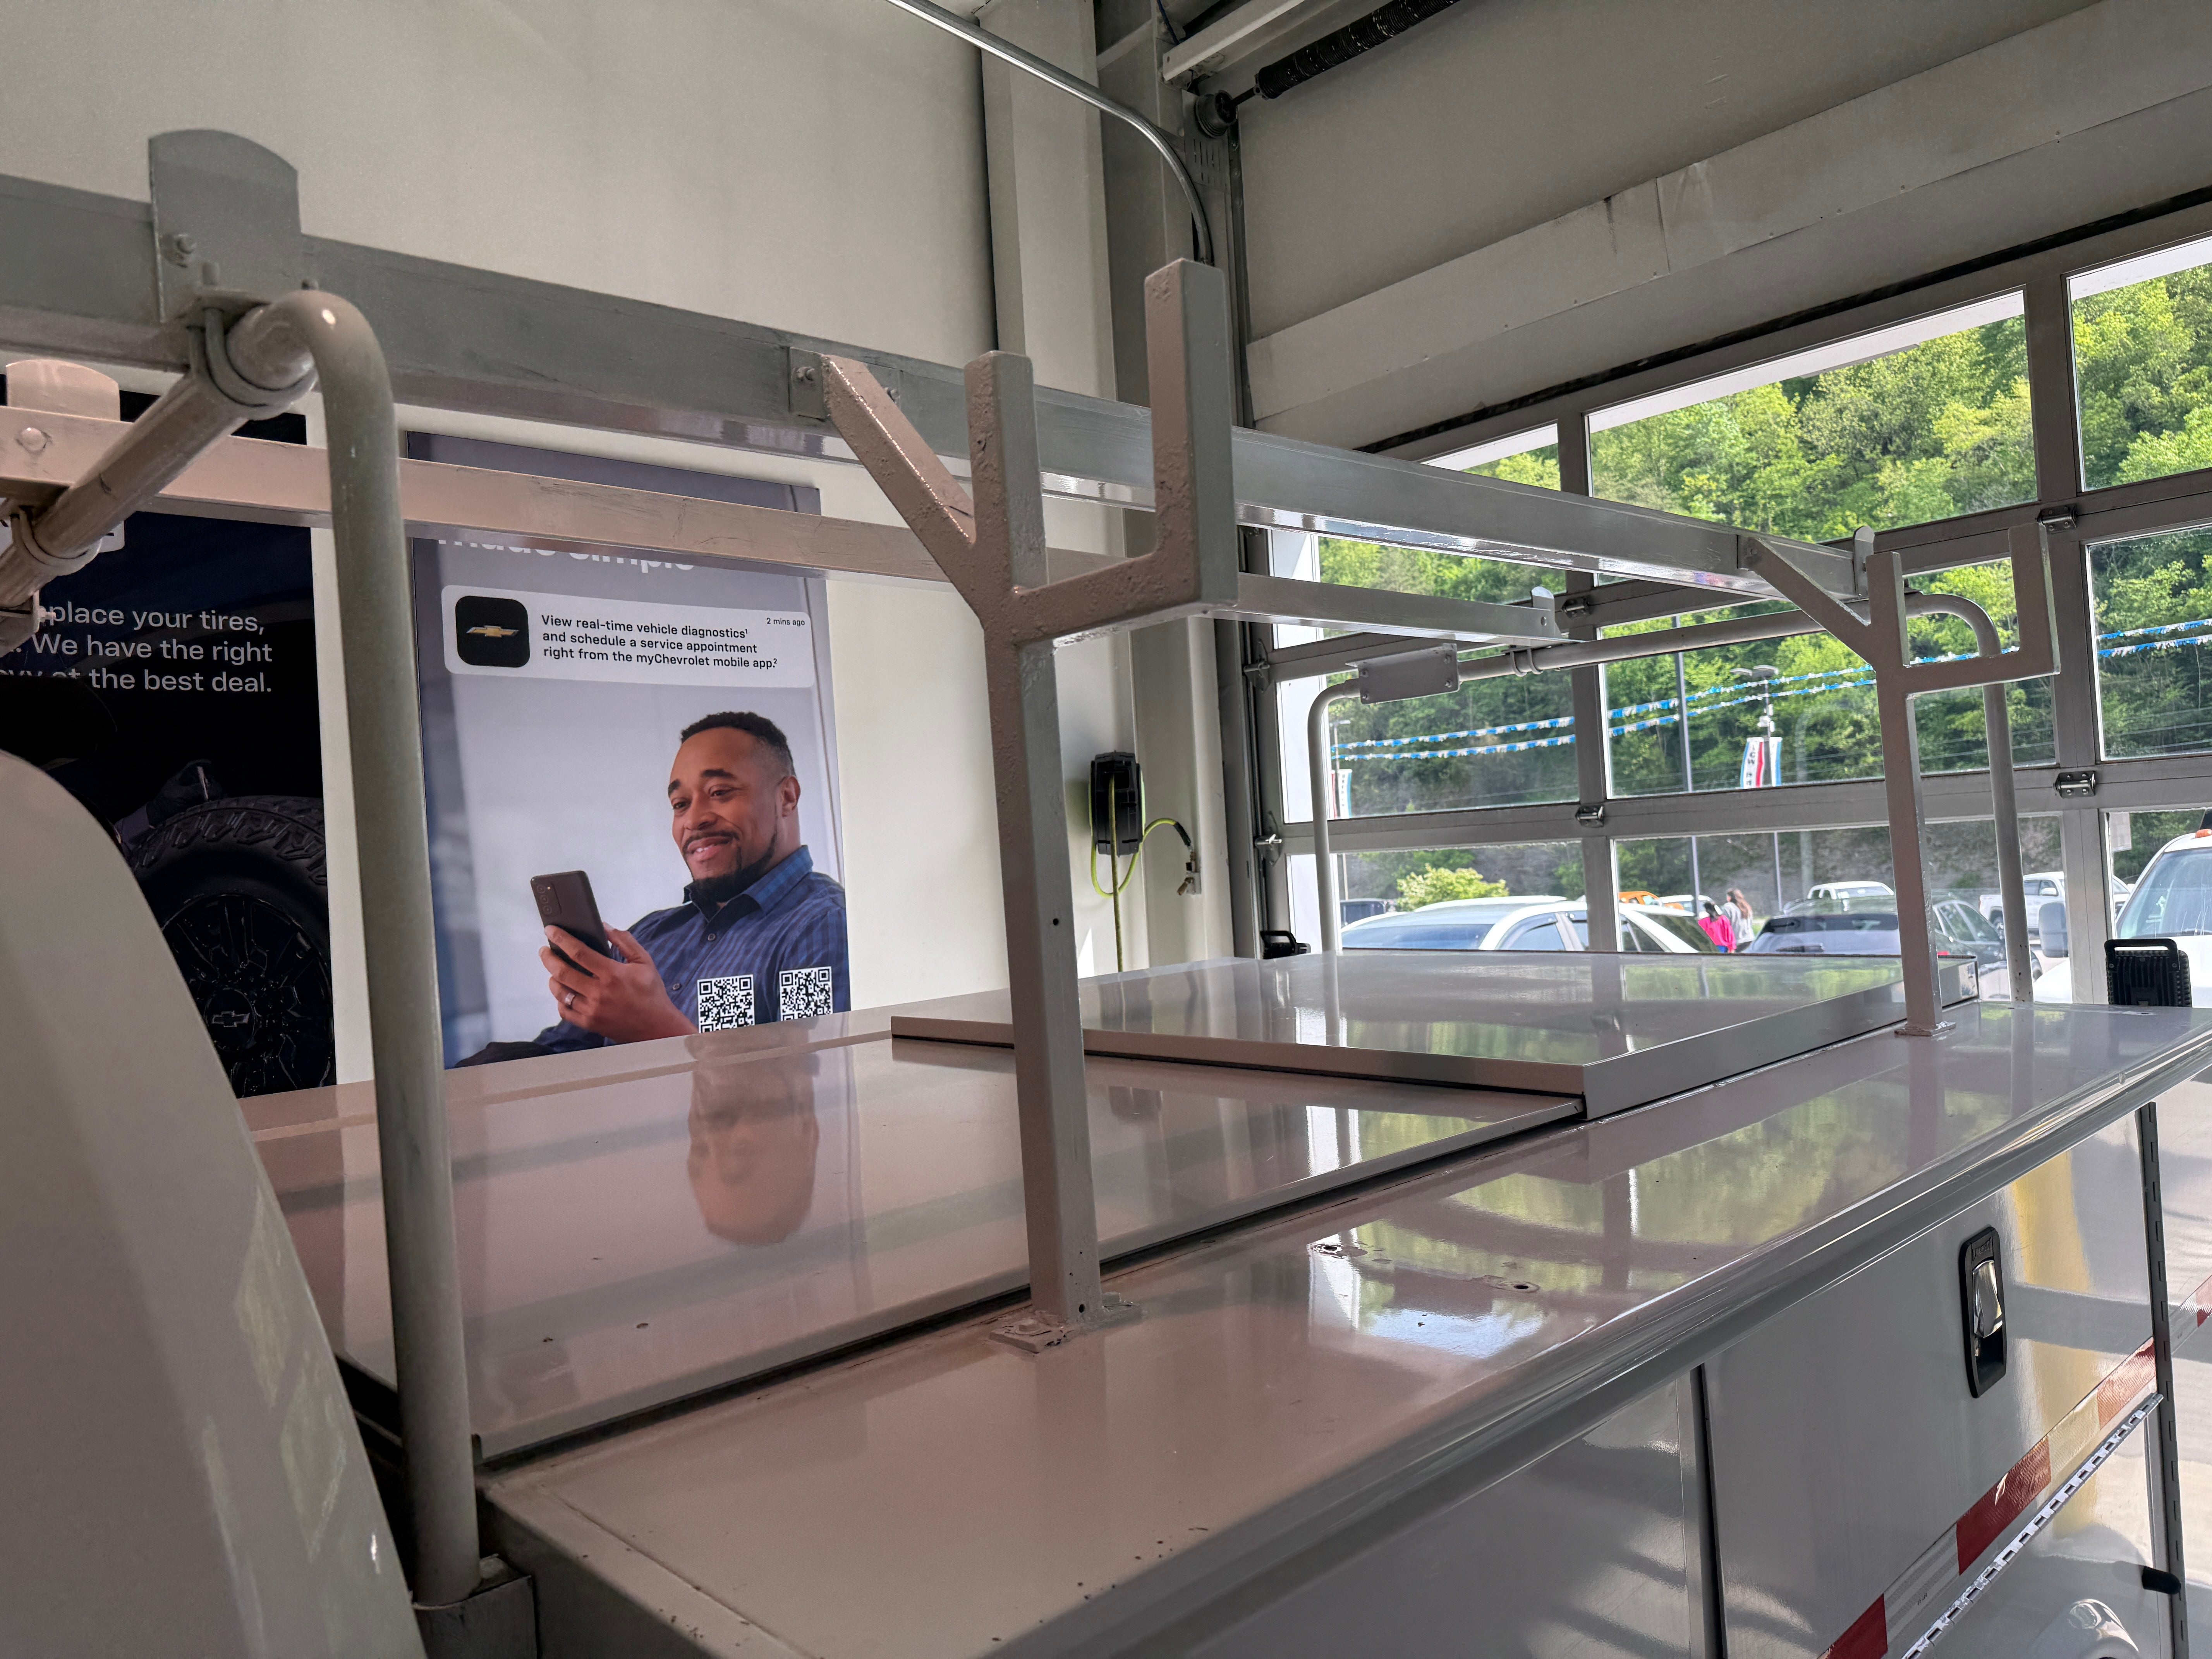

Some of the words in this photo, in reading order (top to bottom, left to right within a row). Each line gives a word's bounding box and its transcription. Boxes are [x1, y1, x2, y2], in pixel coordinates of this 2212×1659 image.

[40, 601, 124, 626] place
[132, 611, 192, 630] your
[199, 610, 264, 635] tires,
[541, 615, 572, 627] View
[577, 619, 633, 632] real-time
[637, 623, 677, 635] vehicle
[32, 633, 77, 655] We
[87, 634, 152, 658] have
[160, 639, 204, 660] the
[213, 641, 272, 666] right
[543, 632, 566, 642] and
[570, 633, 626, 646] schedule
[630, 639, 636, 647] a
[640, 639, 683, 649] service
[687, 642, 757, 653] appointment
[544, 646, 574, 659] right
[578, 648, 608, 661] from
[612, 651, 632, 662] the
[636, 653, 710, 665] myChevrolet
[713, 657, 749, 667] mobile
[89, 667, 135, 689] the
[144, 669, 204, 691] best
[212, 671, 271, 692] deal.
